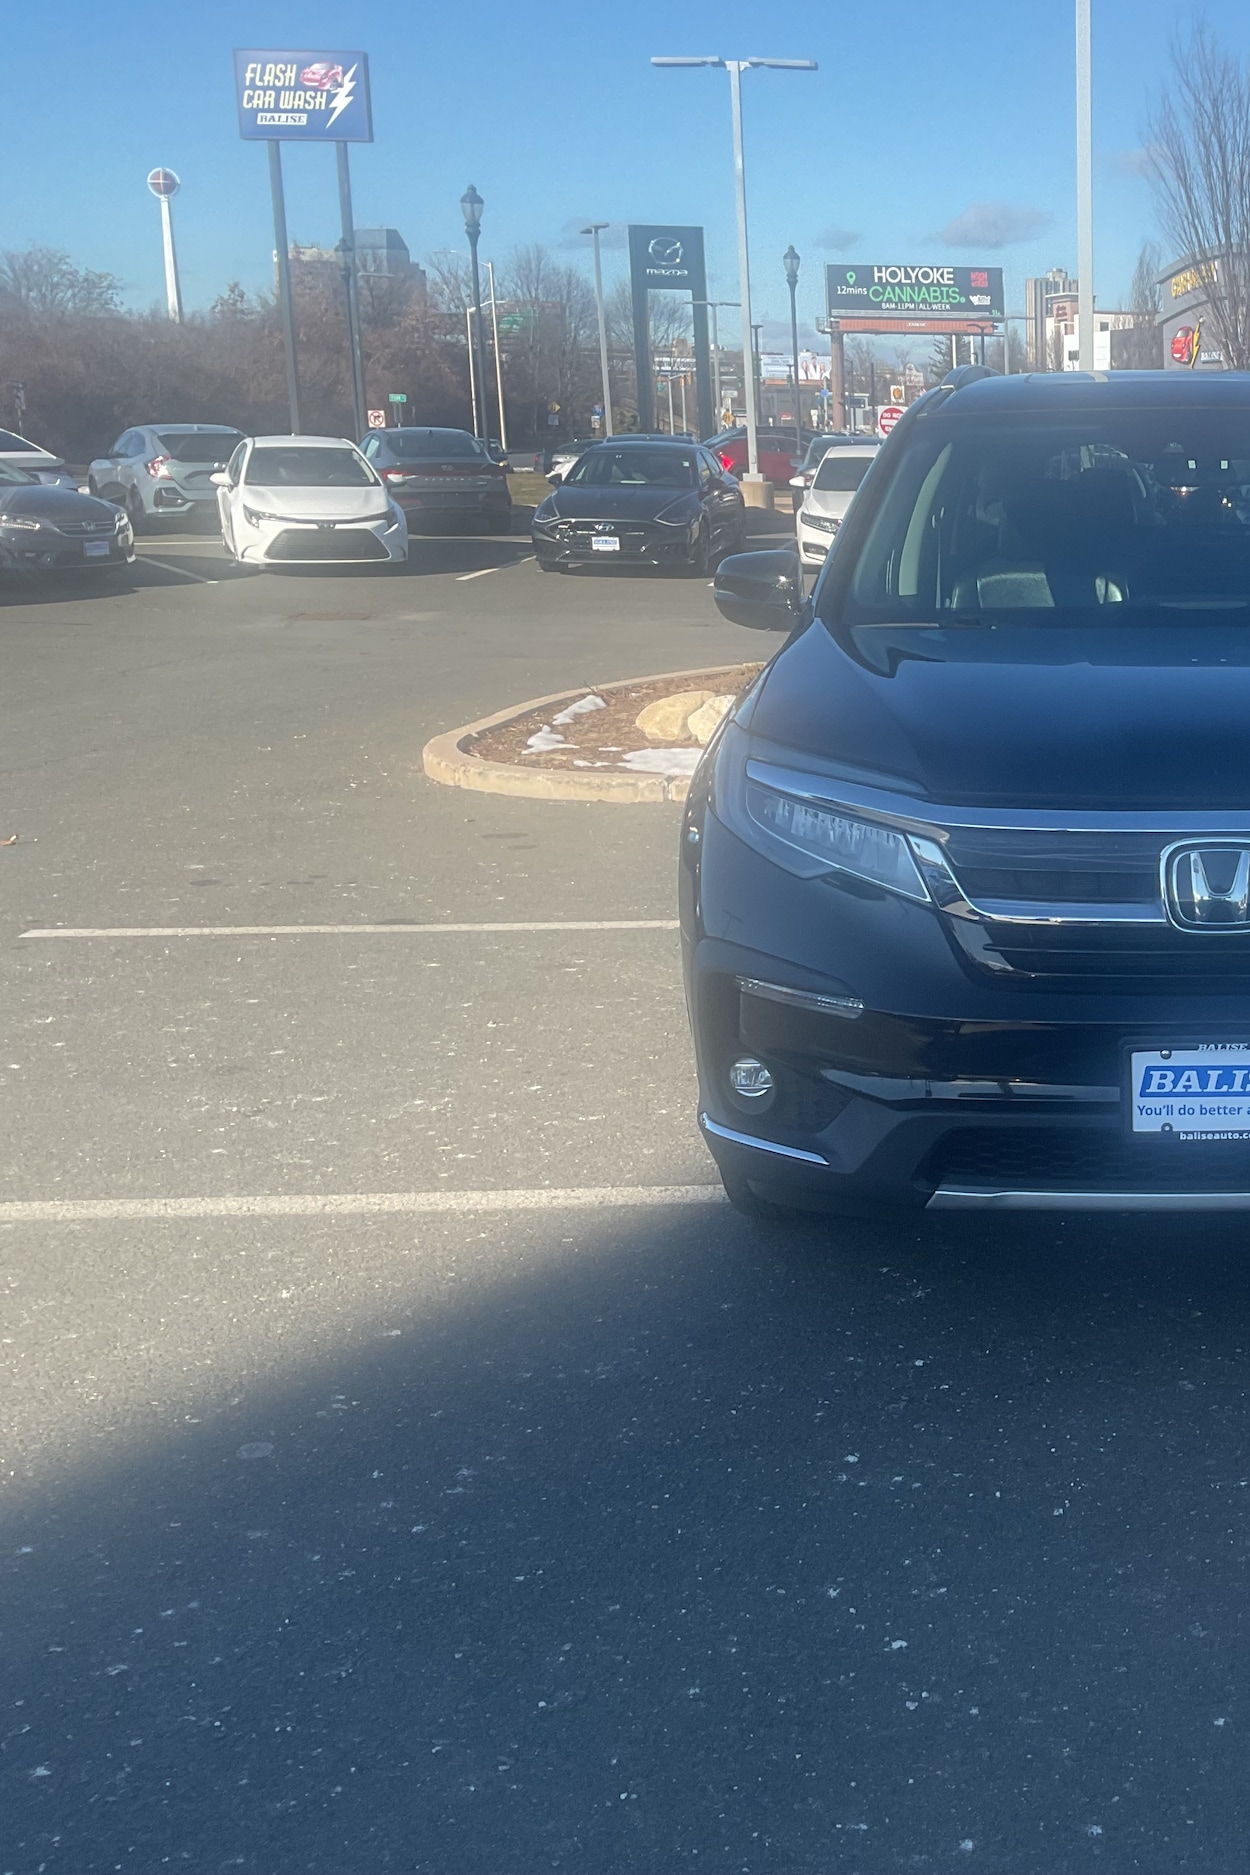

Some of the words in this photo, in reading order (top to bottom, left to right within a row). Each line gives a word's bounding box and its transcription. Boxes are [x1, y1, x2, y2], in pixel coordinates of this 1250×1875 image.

[245, 63, 297, 87] FLASH
[243, 89, 275, 109] CAR
[279, 90, 327, 110] WASH
[259, 114, 305, 124] BALISE
[645, 268, 688, 276] mazda
[873, 266, 954, 284] HOLYOKE
[836, 285, 868, 295] 12mins
[881, 302, 915, 310] 8AM-11PM
[918, 303, 951, 311] ALL-WEEK
[1197, 1043, 1248, 1051] BALISE
[1137, 1105, 1174, 1116] You'll
[1178, 1105, 1195, 1116] do
[1200, 1104, 1243, 1116] better
